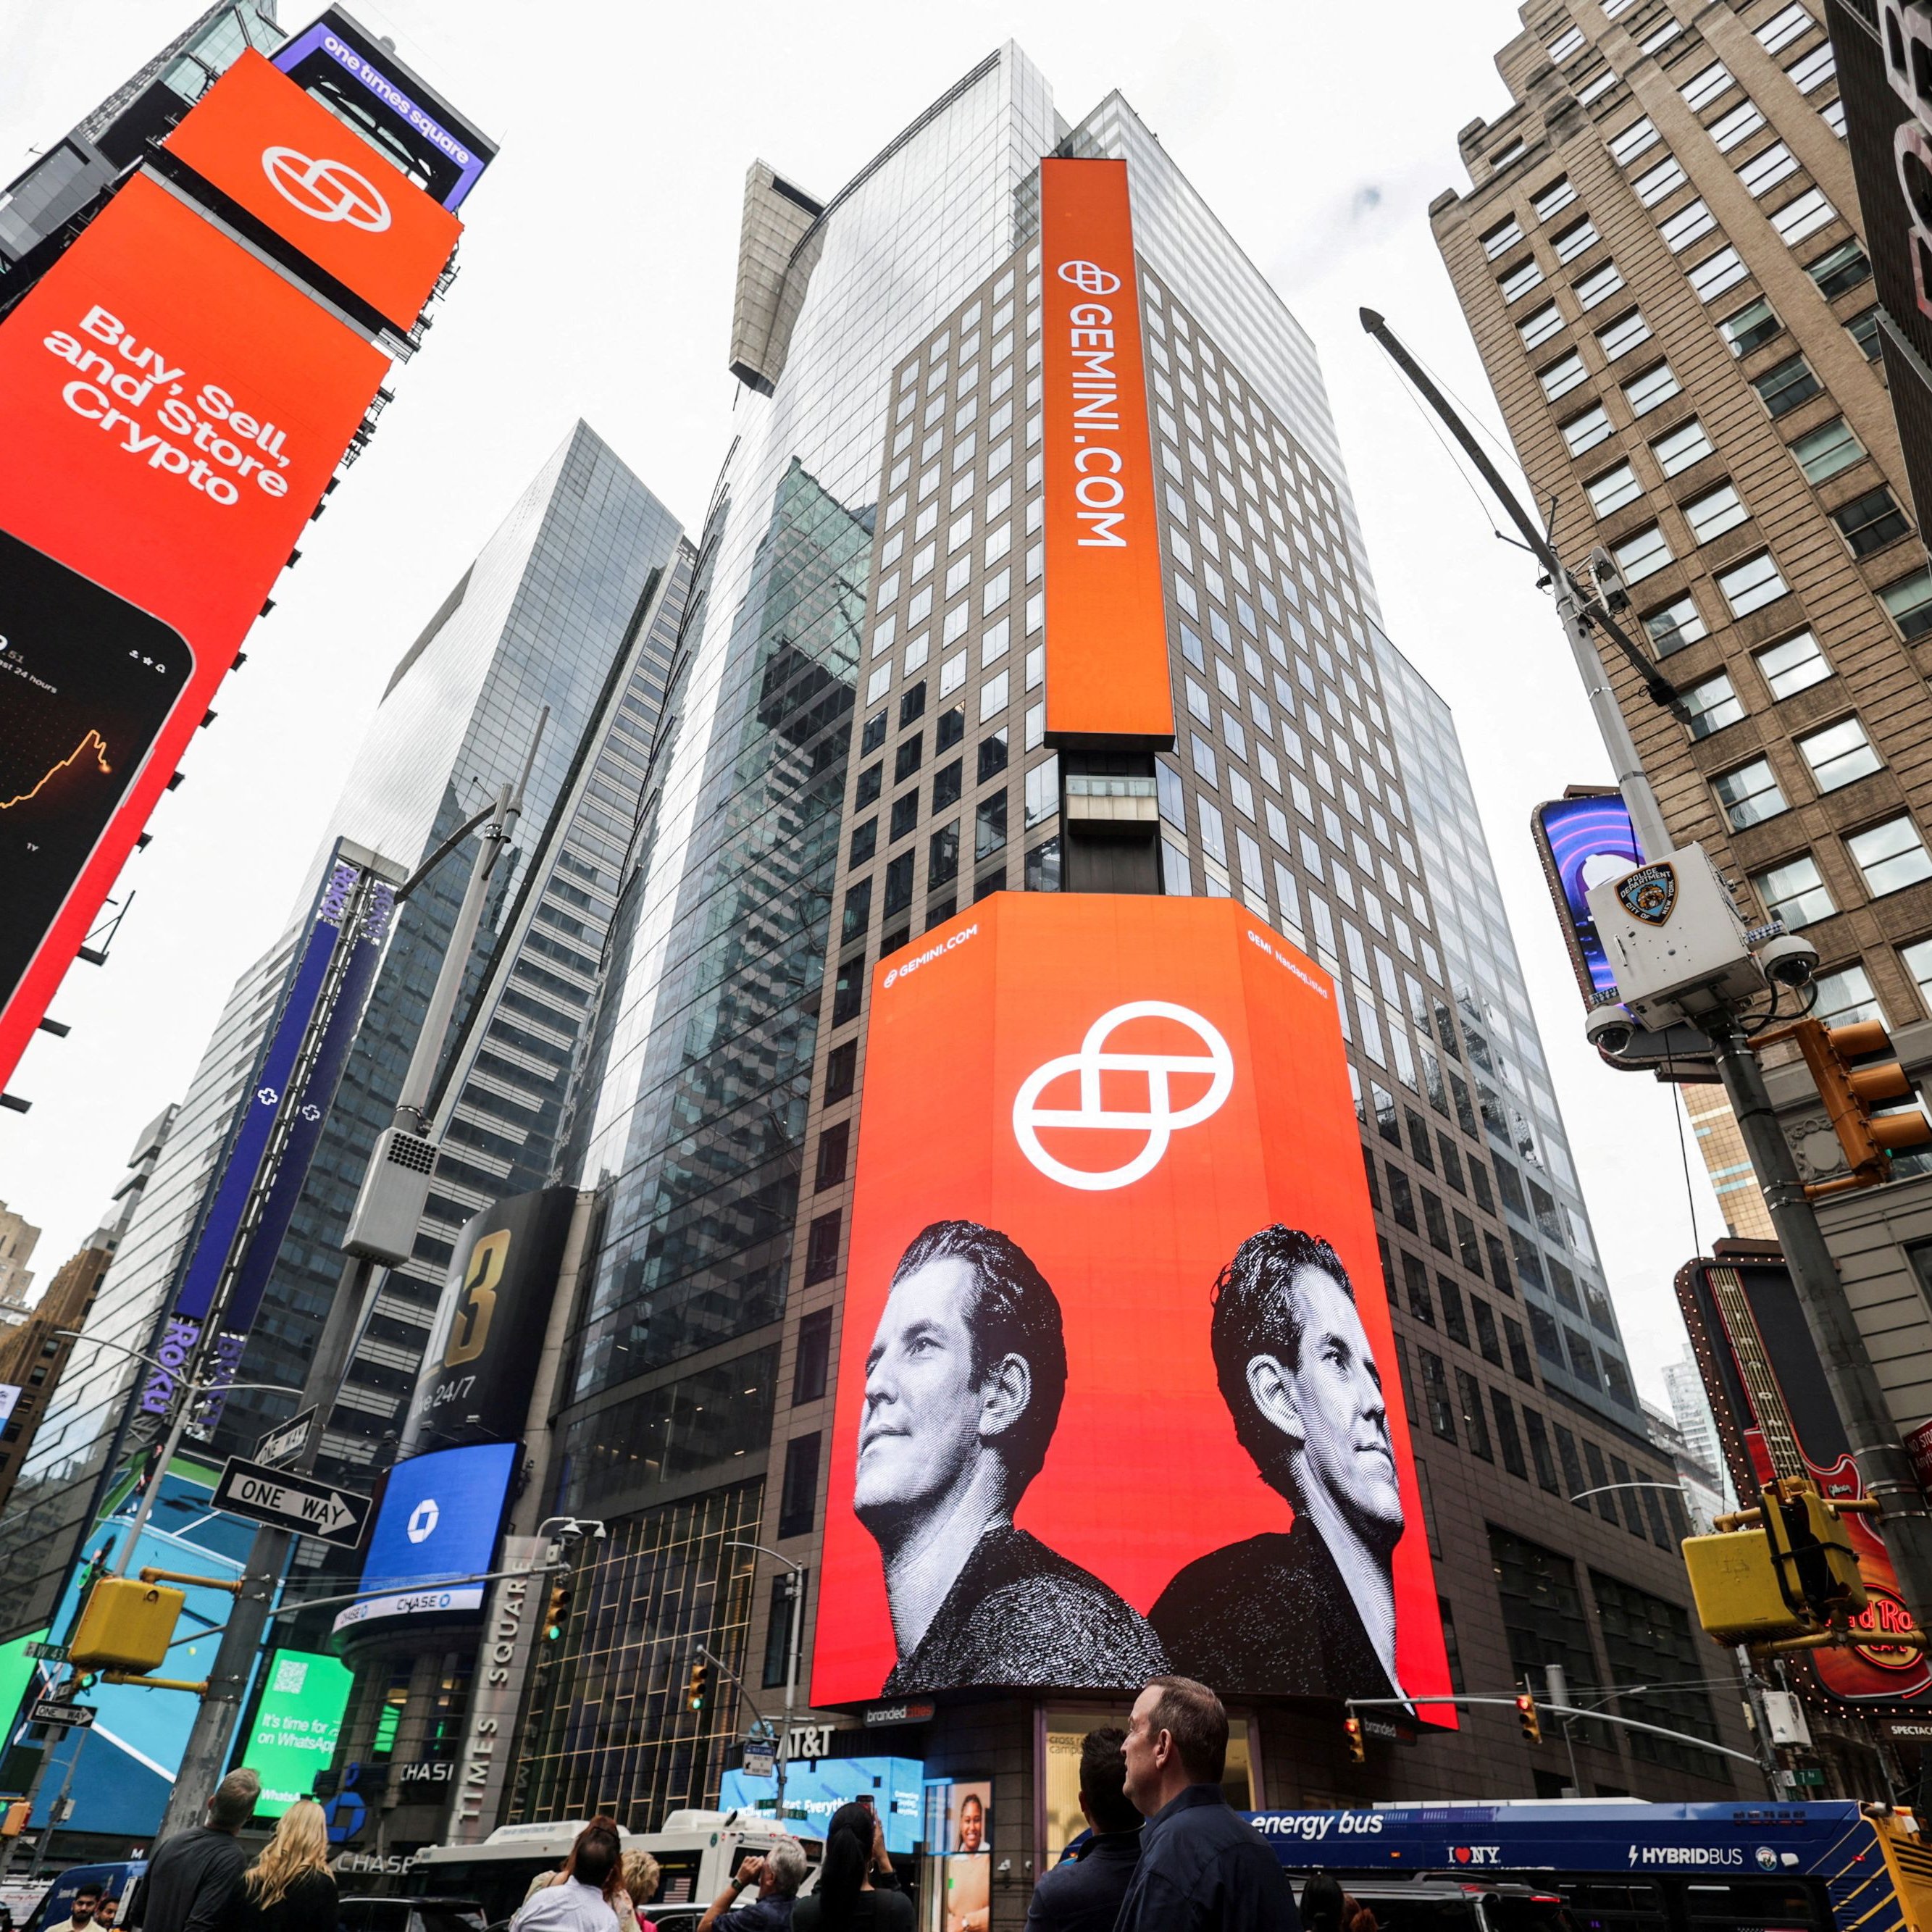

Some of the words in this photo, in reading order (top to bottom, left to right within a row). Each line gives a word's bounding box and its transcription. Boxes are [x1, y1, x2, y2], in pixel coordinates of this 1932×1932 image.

[325, 36, 361, 70] one
[360, 62, 411, 114] times
[409, 109, 469, 164] square
[79, 304, 185, 396] Buy,
[196, 384, 290, 468] Sell,
[43, 330, 154, 407] and
[156, 398, 288, 498] Store
[1069, 303, 1127, 548] GEMINI.COM
[62, 380, 239, 506] Crypto
[29, 674, 58, 693] hours
[1620, 871, 1671, 899] DEPARTMENT
[1627, 867, 1658, 885] POLICE
[1626, 902, 1641, 915] CITY
[1661, 899, 1672, 915] NEW
[899, 924, 978, 977] GEMINI.COM
[1247, 929, 1272, 955] GEMI
[432, 1375, 477, 1408] 24/7
[241, 1480, 285, 1509] ONE
[301, 1497, 346, 1526] WAY
[396, 1595, 438, 1611] CHASE
[457, 1717, 498, 1824] TIMES
[488, 1560, 531, 1685] SQUARE
[38, 1706, 57, 1717] ONE
[67, 1710, 88, 1720] WAY
[283, 1716, 309, 1732] time
[311, 1719, 329, 1734] for
[256, 1732, 275, 1745] on
[776, 1725, 836, 1760] AT&T
[1891, 1726, 1932, 1736] SPECTAC
[260, 1788, 301, 1802] WhatsA
[1250, 1814, 1336, 1840] energy
[1338, 1810, 1384, 1834] bus
[1447, 1847, 1457, 1864] I
